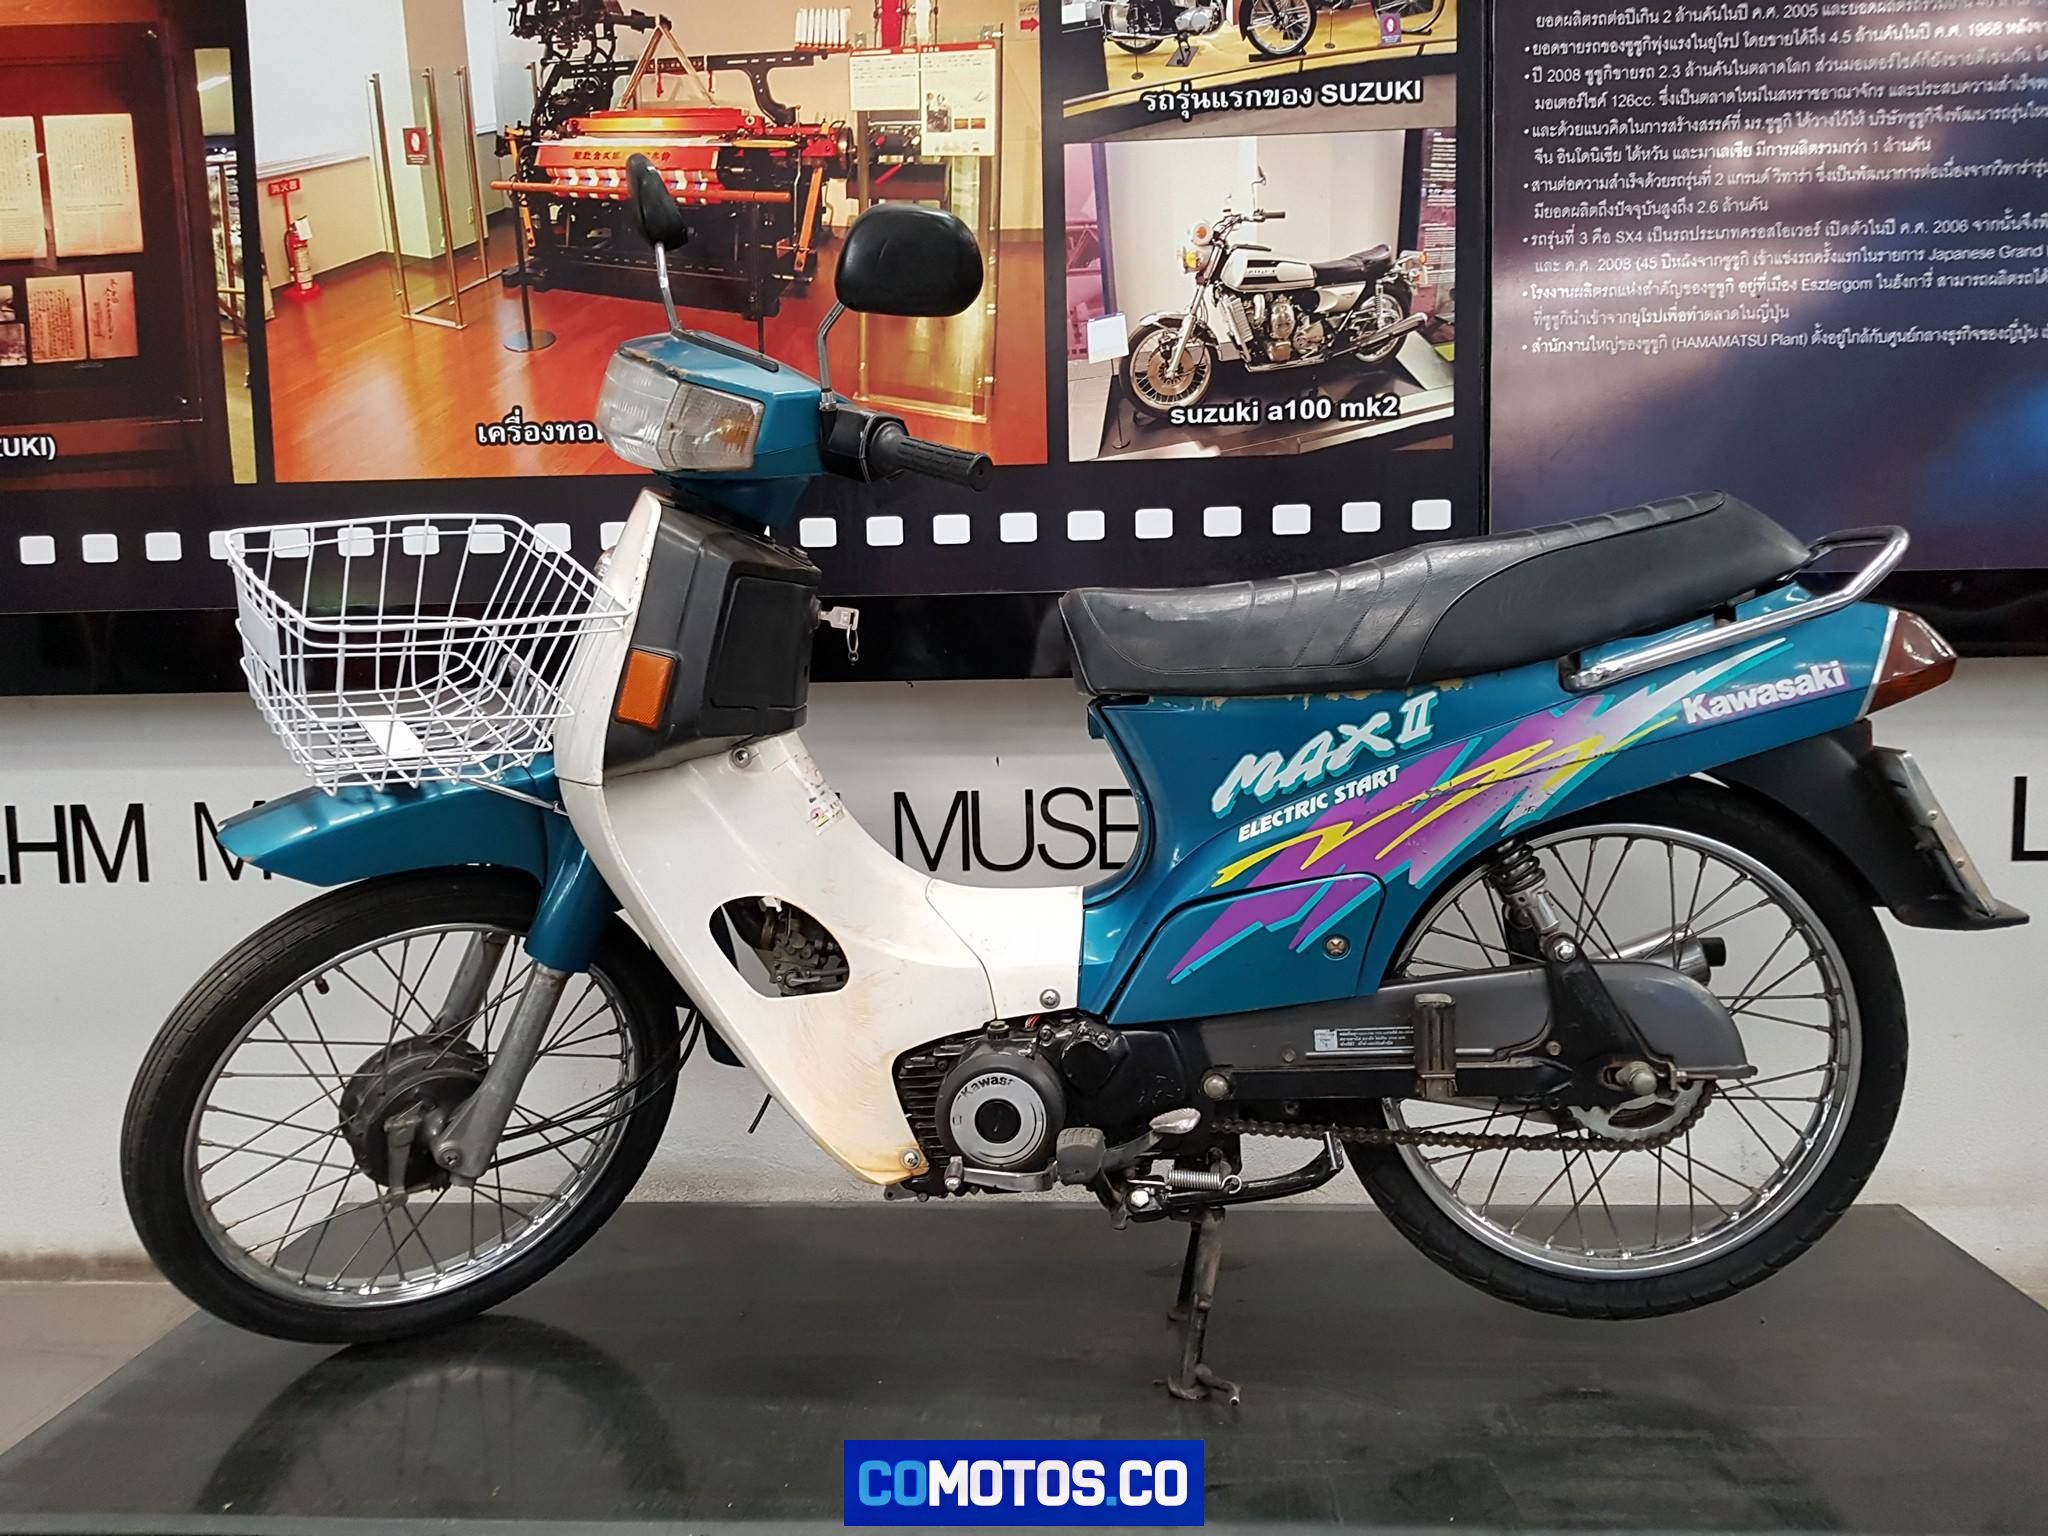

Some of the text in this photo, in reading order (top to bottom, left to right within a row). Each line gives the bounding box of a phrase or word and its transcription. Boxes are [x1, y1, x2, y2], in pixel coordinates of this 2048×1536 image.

[1663, 10, 1672, 24] 2
[1784, 3, 1818, 18] 2005
[1829, 27, 1851, 46] 4.5
[1532, 65, 1543, 83] ปี
[1547, 68, 1581, 82] 2008
[1658, 63, 1681, 78] 2.3
[1142, 80, 1421, 120] รถรุ่นแรกของ SUZUKI
[1534, 148, 1553, 165] จีน
[1714, 173, 1723, 187] 2
[1697, 199, 1718, 214] 2.6
[1722, 195, 1769, 214] ล้านคัน
[1530, 224, 1575, 250] รถรุ่นที่
[1579, 231, 1588, 245] 3
[1615, 230, 1643, 244] SX4
[1933, 220, 1969, 235] 2006
[1929, 247, 1995, 263] Japanese
[1998, 244, 2043, 259] Grand
[1801, 276, 1872, 294] Esztergom
[1671, 335, 1767, 350] (HAMAMATSU
[1771, 332, 1807, 348] Plant)
[1170, 395, 1399, 425] suzuki a100 mk2
[478, 408, 604, 443] เครื่องทอ
[1682, 662, 1846, 724] Kawasaki
[1211, 720, 1392, 816] MAX
[1238, 764, 1399, 842] ELECTRIC START
